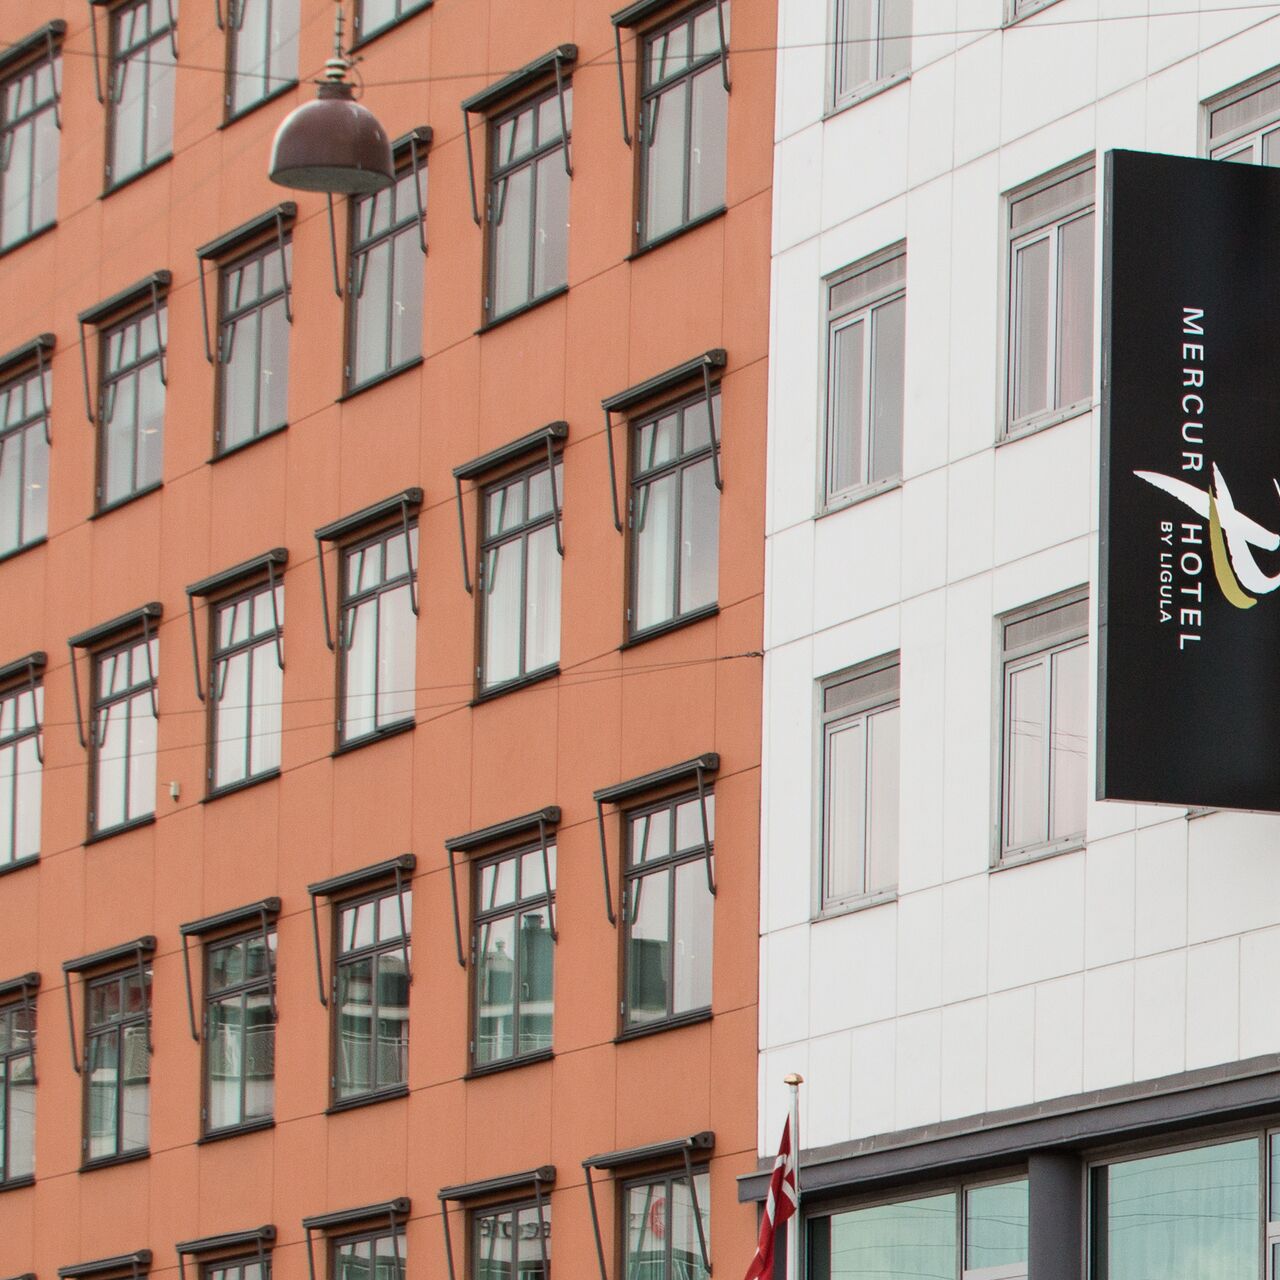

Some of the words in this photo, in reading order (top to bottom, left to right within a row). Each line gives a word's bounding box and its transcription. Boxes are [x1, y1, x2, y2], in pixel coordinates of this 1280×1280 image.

[1182, 308, 1203, 471] MERCUR
[1161, 522, 1172, 545] BY
[1160, 553, 1172, 622] LIGULA
[1180, 524, 1202, 649] HOTEL
